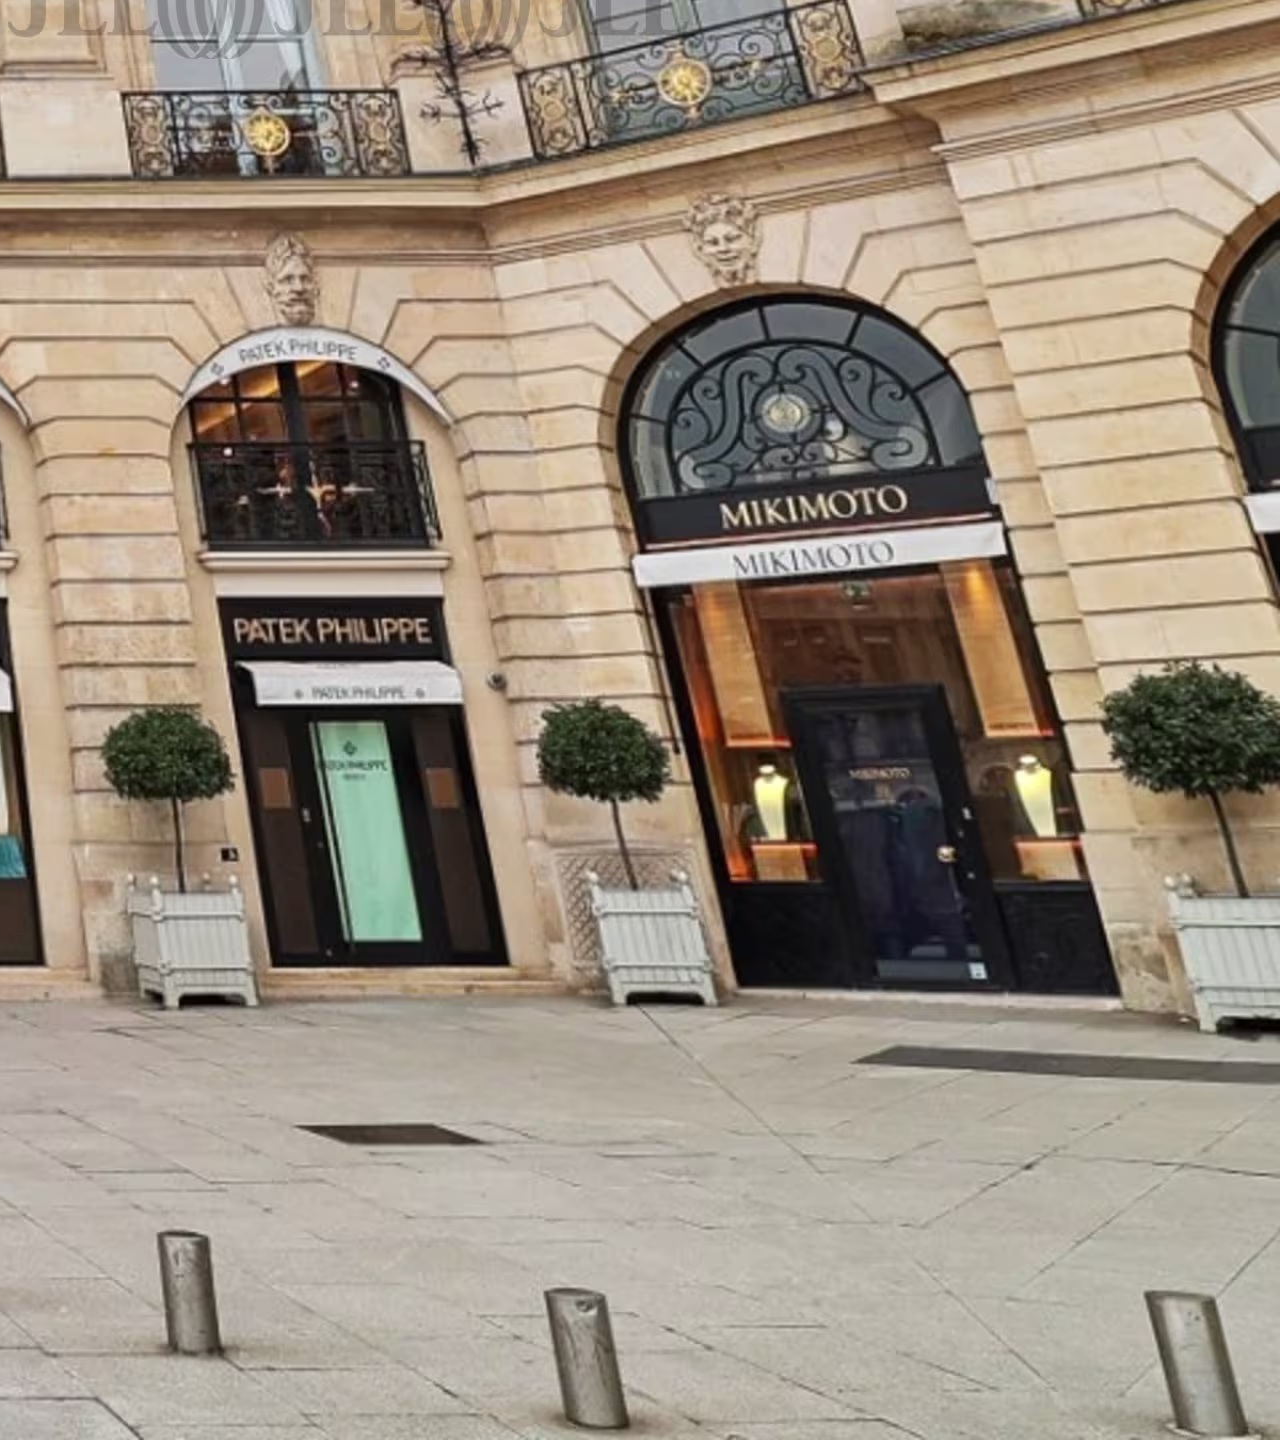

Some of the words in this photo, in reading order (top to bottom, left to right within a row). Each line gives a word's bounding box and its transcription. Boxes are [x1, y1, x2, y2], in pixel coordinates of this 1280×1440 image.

[238, 340, 288, 362] PATEK
[289, 338, 358, 360] PHILIPPE
[719, 483, 908, 530] MIKIMOTO
[732, 539, 895, 576] MIKIMOTO
[233, 617, 314, 644] PATEK
[316, 617, 433, 644] PHILIPPE
